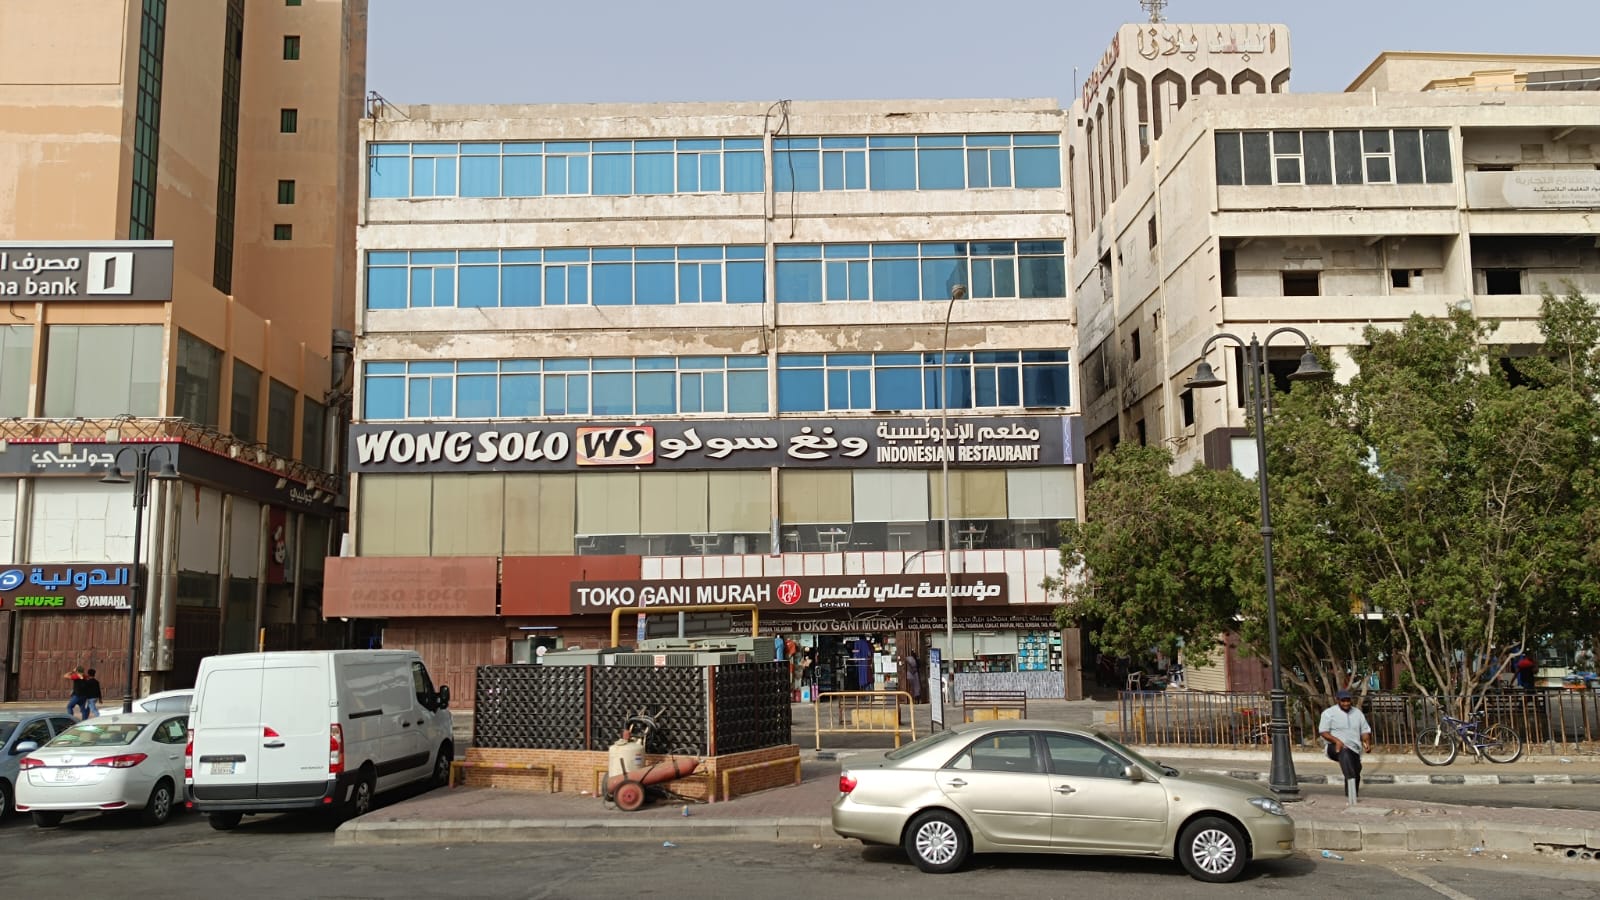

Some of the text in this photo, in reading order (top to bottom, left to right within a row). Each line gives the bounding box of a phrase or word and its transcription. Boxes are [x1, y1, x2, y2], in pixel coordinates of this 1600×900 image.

[12, 252, 81, 274] مصرف
[26, 276, 78, 295] bank
[659, 426, 868, 459] ونغ سولو
[977, 423, 1040, 443] مطعم
[356, 430, 569, 464] WONG SOLO
[583, 429, 645, 459] WS
[876, 444, 1041, 462] INDONESIAN RESTAURANT
[31, 448, 115, 468] جوليبي
[29, 568, 128, 591] الدولية
[15, 596, 65, 606] SHURE
[88, 595, 126, 607] YAMAHA
[577, 583, 770, 606] TOKO GANI MURAH
[808, 579, 1001, 603] مؤسسة علي شمس
[798, 620, 828, 631] TOKO
[831, 618, 859, 631] GANI
[862, 617, 904, 630] MURAH
